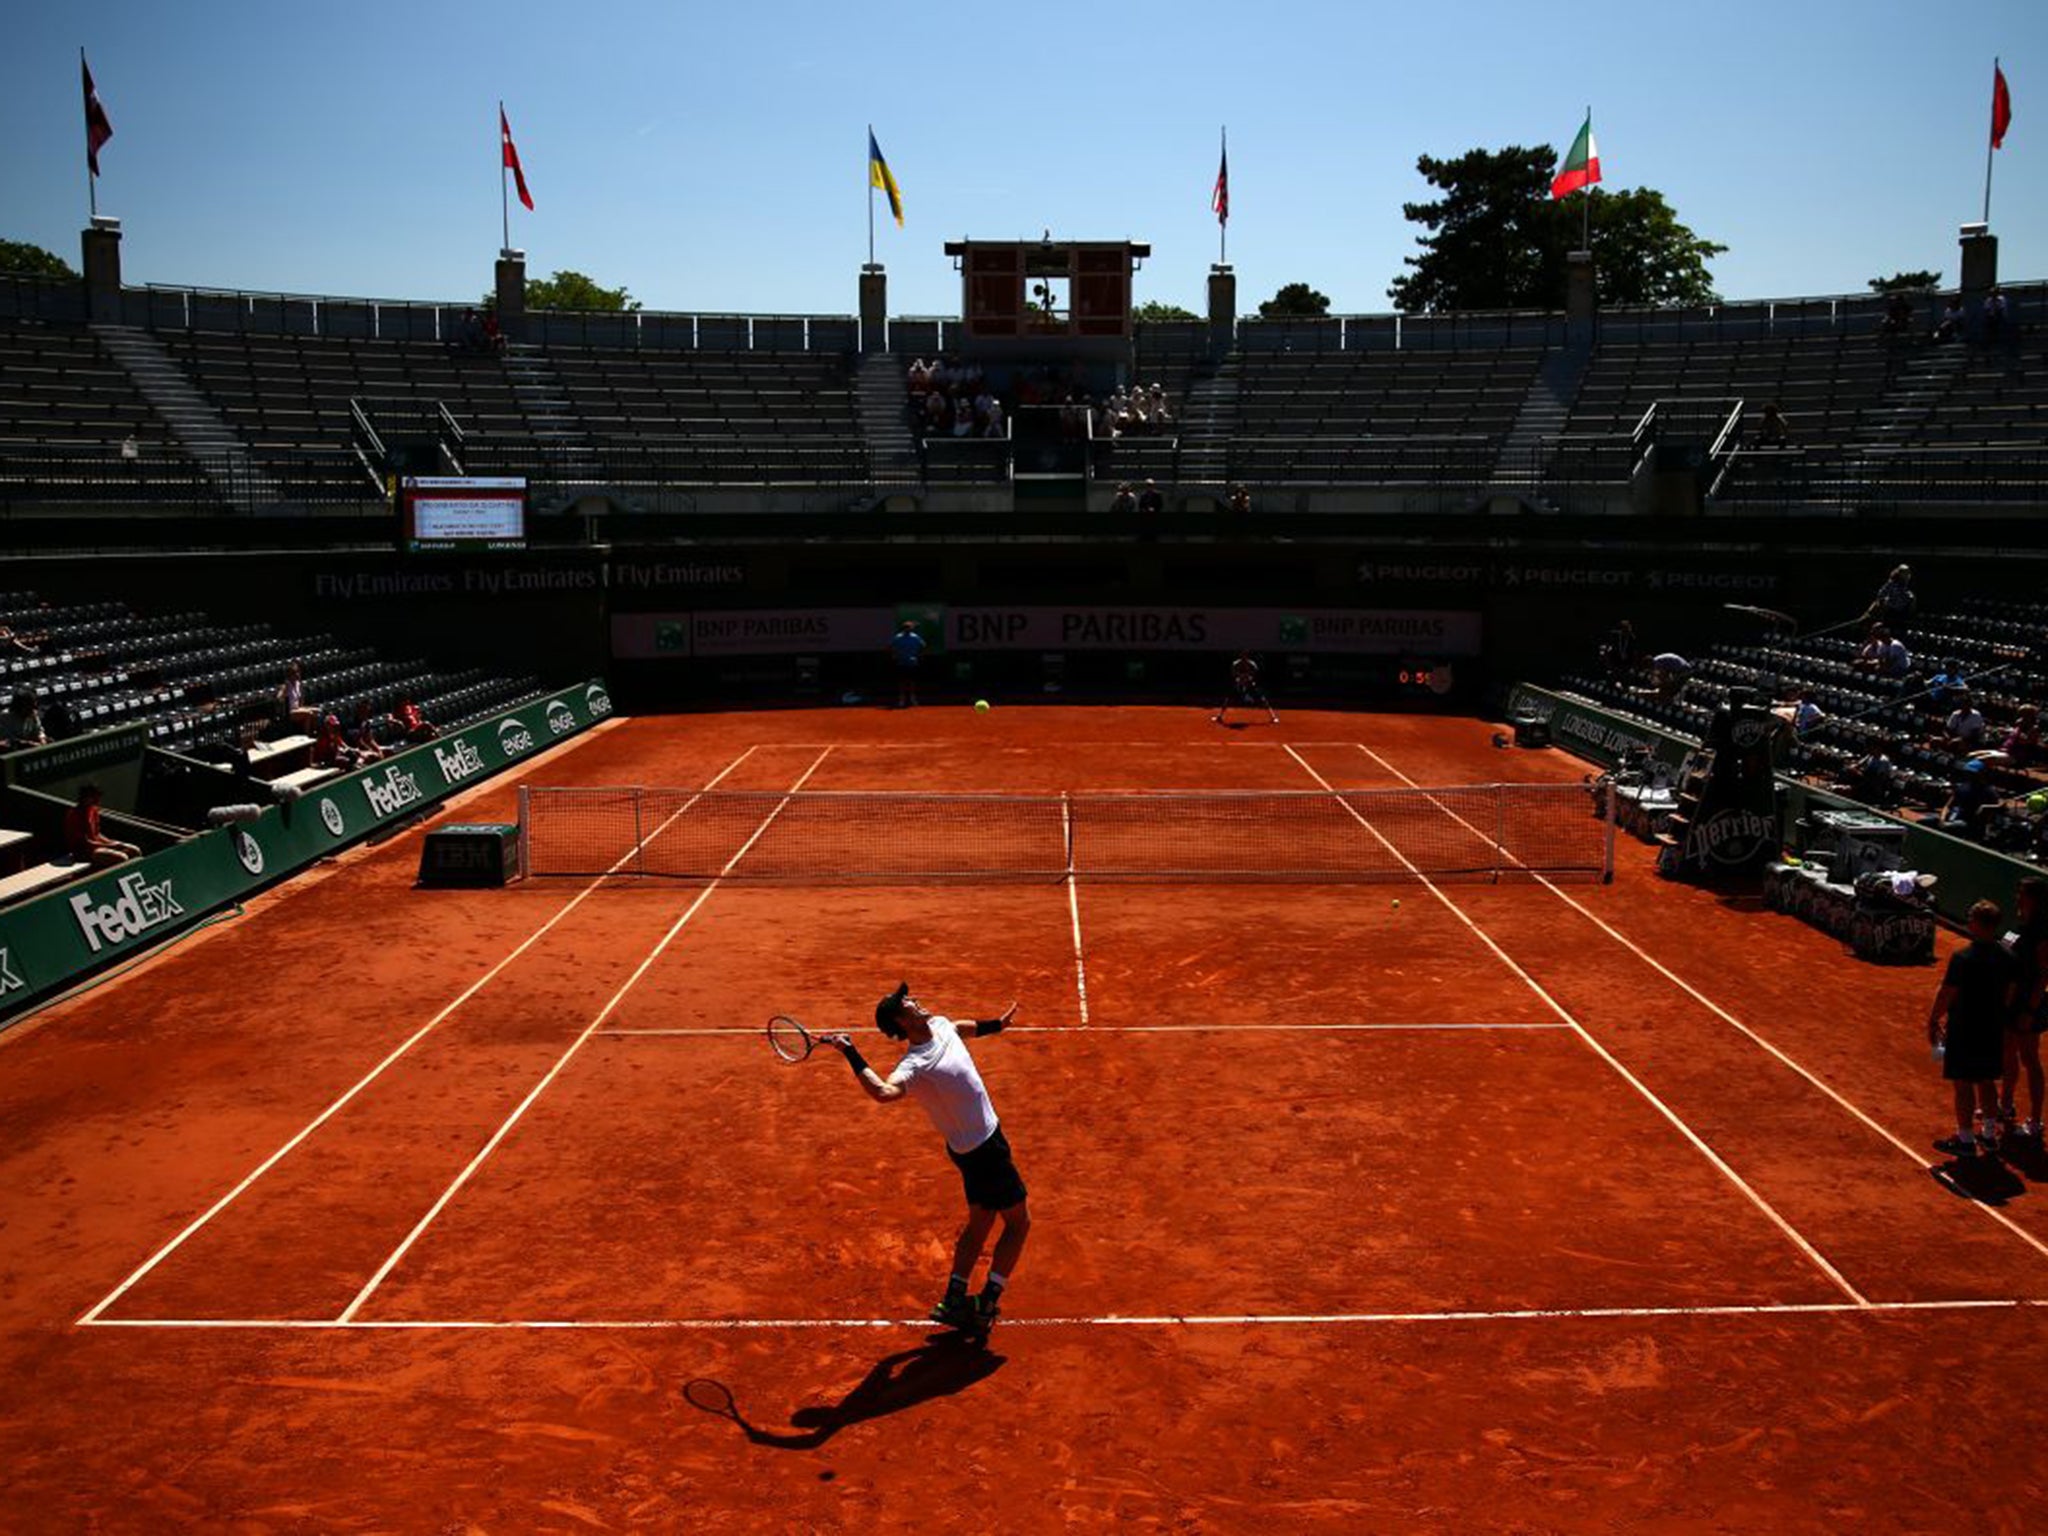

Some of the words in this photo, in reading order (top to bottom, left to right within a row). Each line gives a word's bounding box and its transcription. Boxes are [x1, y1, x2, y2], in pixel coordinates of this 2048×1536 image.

[1376, 564, 1484, 583] PEUGEOT
[1525, 567, 1634, 586] PEUGEOT
[1666, 571, 1777, 590] PEUGEOT
[697, 619, 738, 638] BNP
[744, 616, 829, 636] PARIBAS
[957, 613, 1027, 643] BNP
[1061, 613, 1206, 643] PARIBAS
[1313, 618, 1354, 634] BNP
[1360, 617, 1443, 637] PARIBAS
[433, 737, 485, 785] FedEx
[361, 764, 423, 819] FedEx
[68, 871, 185, 953] FedEx
